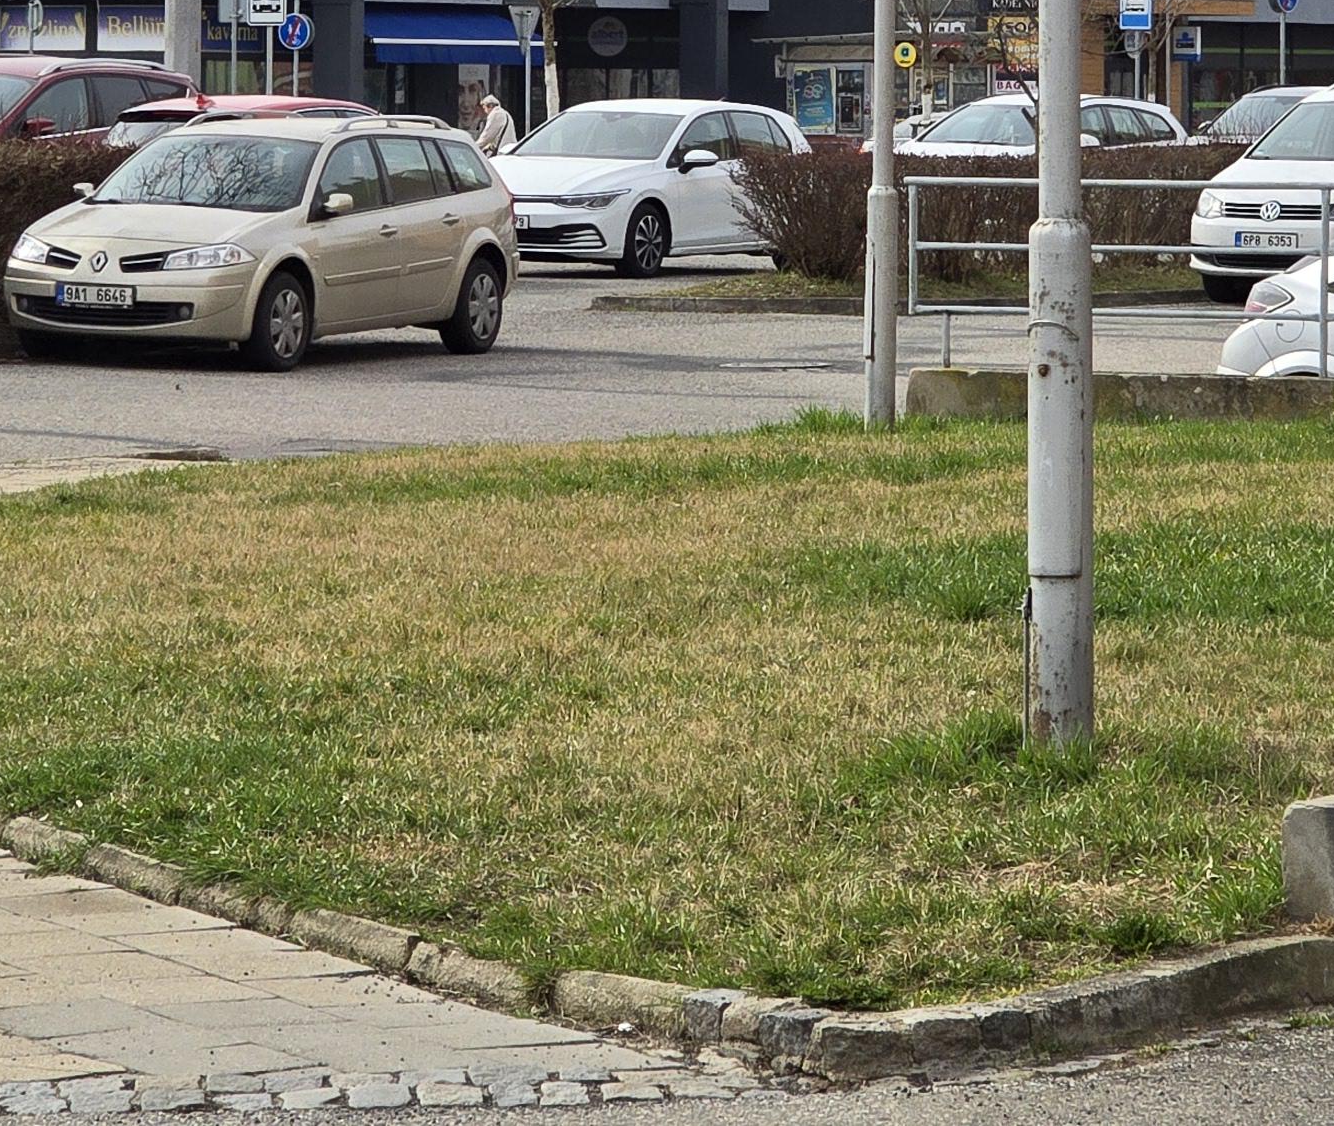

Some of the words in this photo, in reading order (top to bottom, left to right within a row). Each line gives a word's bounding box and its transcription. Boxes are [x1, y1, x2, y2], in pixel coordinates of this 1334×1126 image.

[208, 20, 259, 42] kavrna
[1268, 235, 1292, 247] 6353
[66, 287, 87, 301] 9A1
[96, 288, 126, 303] 6646
